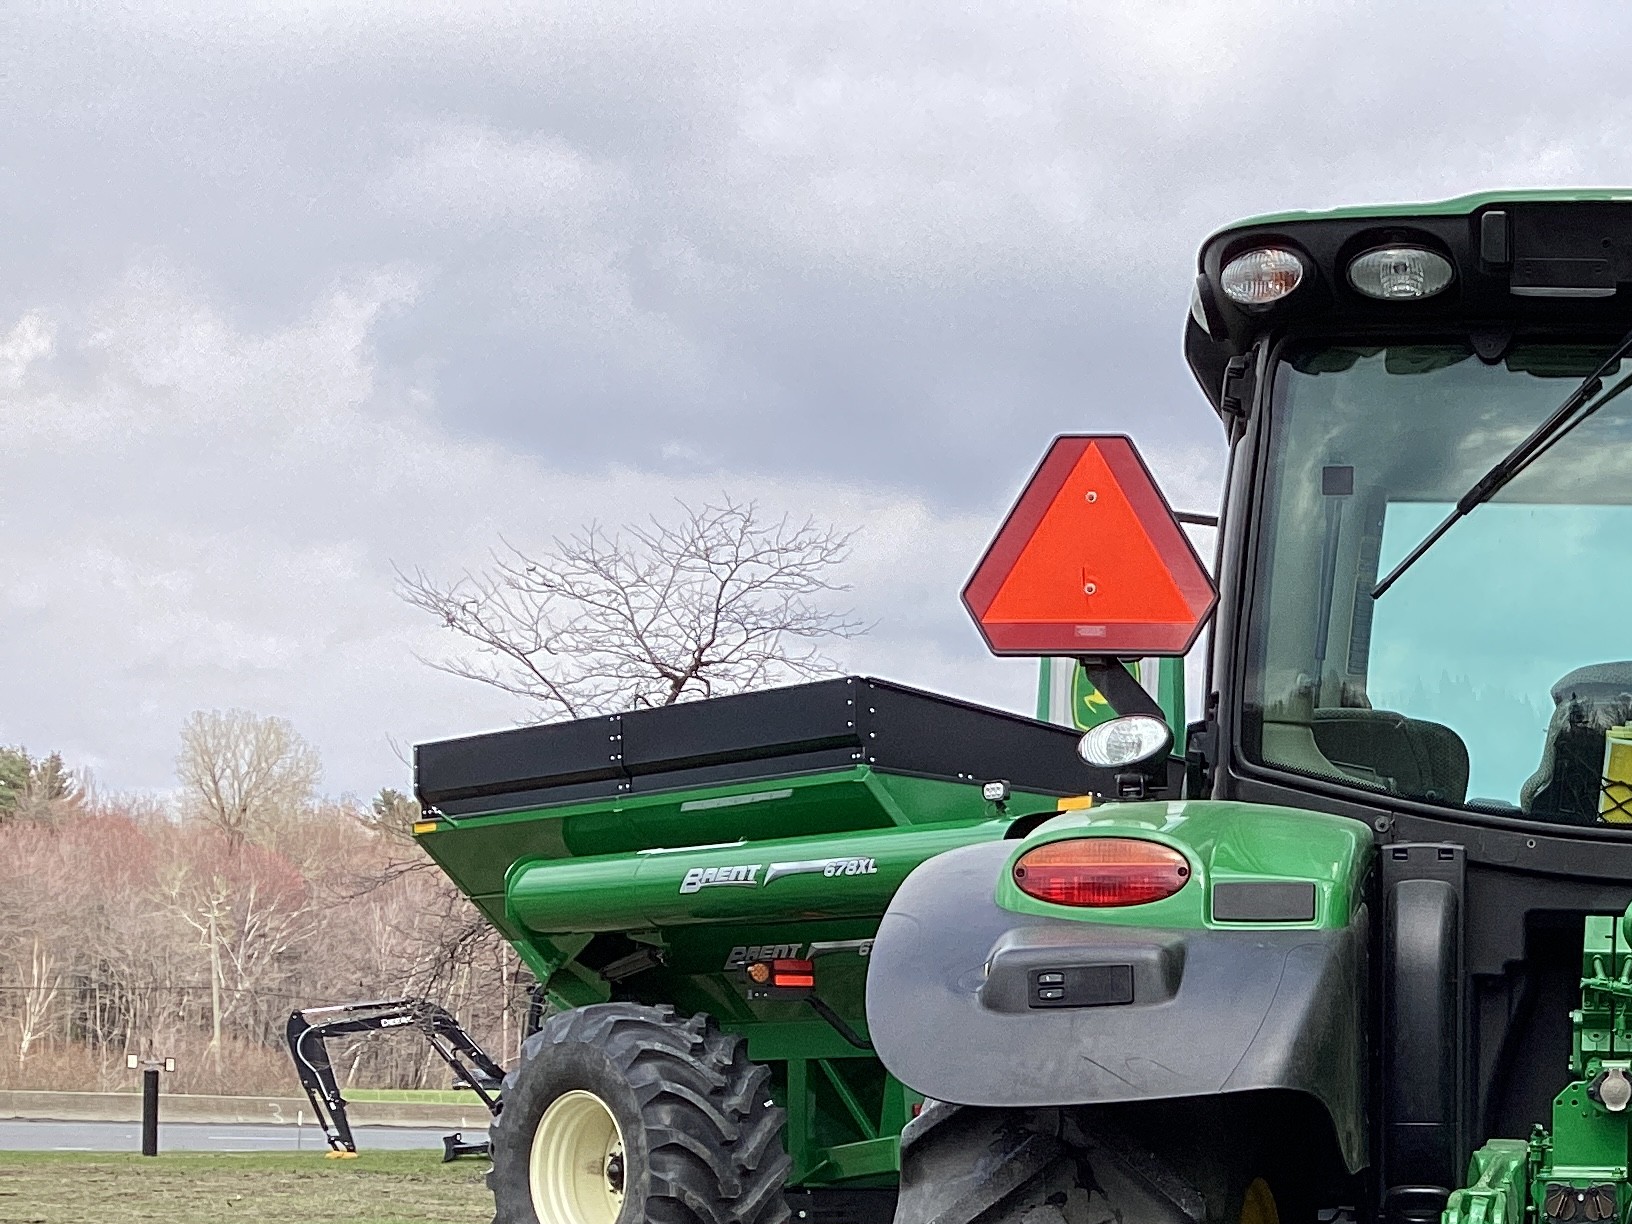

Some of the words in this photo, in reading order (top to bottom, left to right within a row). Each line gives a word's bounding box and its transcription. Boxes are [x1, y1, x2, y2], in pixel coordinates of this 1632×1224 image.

[680, 864, 763, 894] BRENT
[823, 858, 878, 878] 678XL
[723, 943, 803, 970] BRENT
